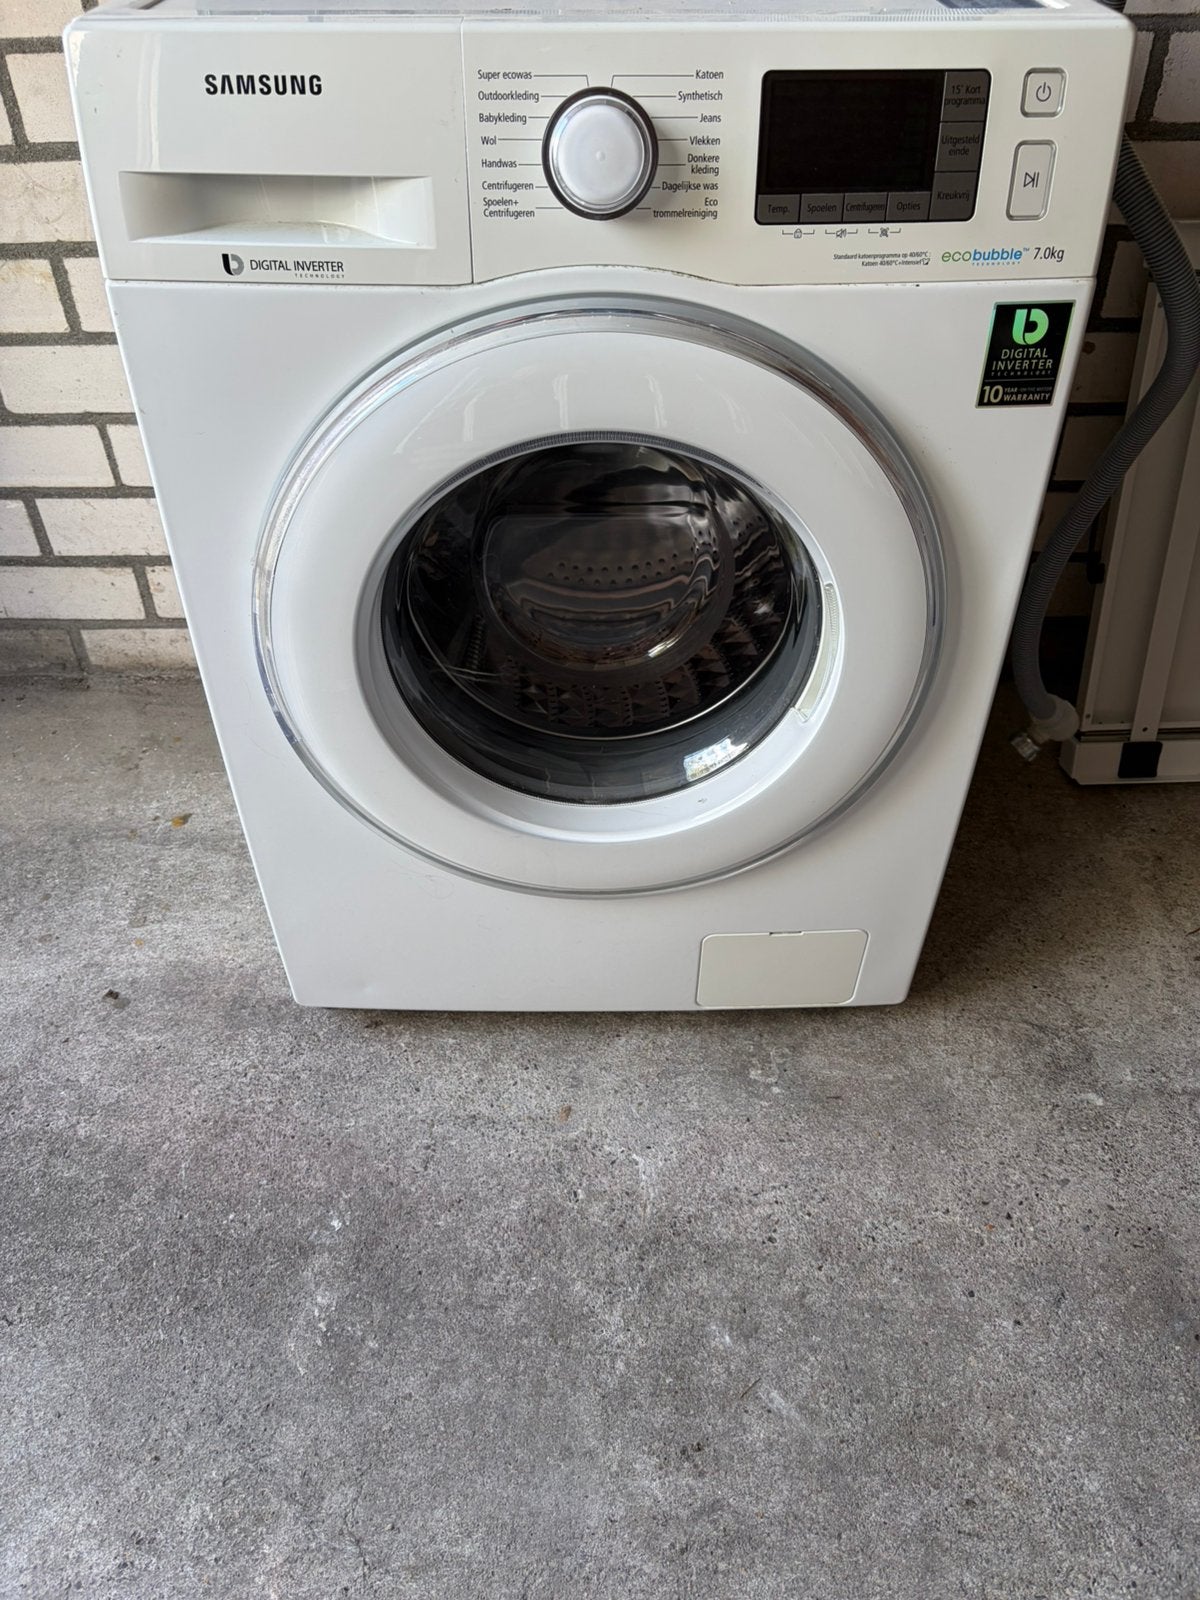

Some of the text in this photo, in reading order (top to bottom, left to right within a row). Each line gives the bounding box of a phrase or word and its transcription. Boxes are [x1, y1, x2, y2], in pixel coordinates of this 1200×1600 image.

[477, 69, 533, 81] Super ecowas
[695, 69, 724, 80] Katoen
[204, 73, 323, 96] SAMSUNG
[965, 84, 981, 95] Kort
[477, 90, 540, 103] Outdoorkleding
[677, 90, 723, 103] Synthetisch
[944, 96, 986, 108] programma
[478, 112, 527, 125] Babykleding
[699, 113, 722, 123] Jeans
[480, 136, 497, 146] Wol
[689, 135, 721, 146] Vlekken
[941, 133, 981, 147] Uitgesteld
[948, 146, 970, 156] einde
[481, 158, 518, 168] Handwas
[687, 153, 720, 164] Donkere
[690, 165, 720, 177] kleding
[481, 180, 534, 192] Centrifugeren
[661, 181, 719, 193] Dagelijkse was
[704, 197, 718, 207] Eco
[936, 190, 970, 202] Kreukvrij
[482, 197, 519, 208] Spoelen+
[845, 202, 886, 214] Centrifugeren
[896, 201, 921, 213] Opties
[483, 208, 535, 220] Centrifugeren
[653, 208, 718, 220] trommelreiniging
[767, 203, 790, 215] Temp.
[807, 203, 837, 215] Spoelen
[1033, 246, 1065, 263] 7.0kg
[249, 259, 344, 272] DIGITAL INVERTER
[1001, 347, 1048, 360] DIGITAL
[991, 359, 1054, 371] INVERTER
[982, 384, 1004, 404] 10
[1003, 393, 1051, 402] WARRANTY
